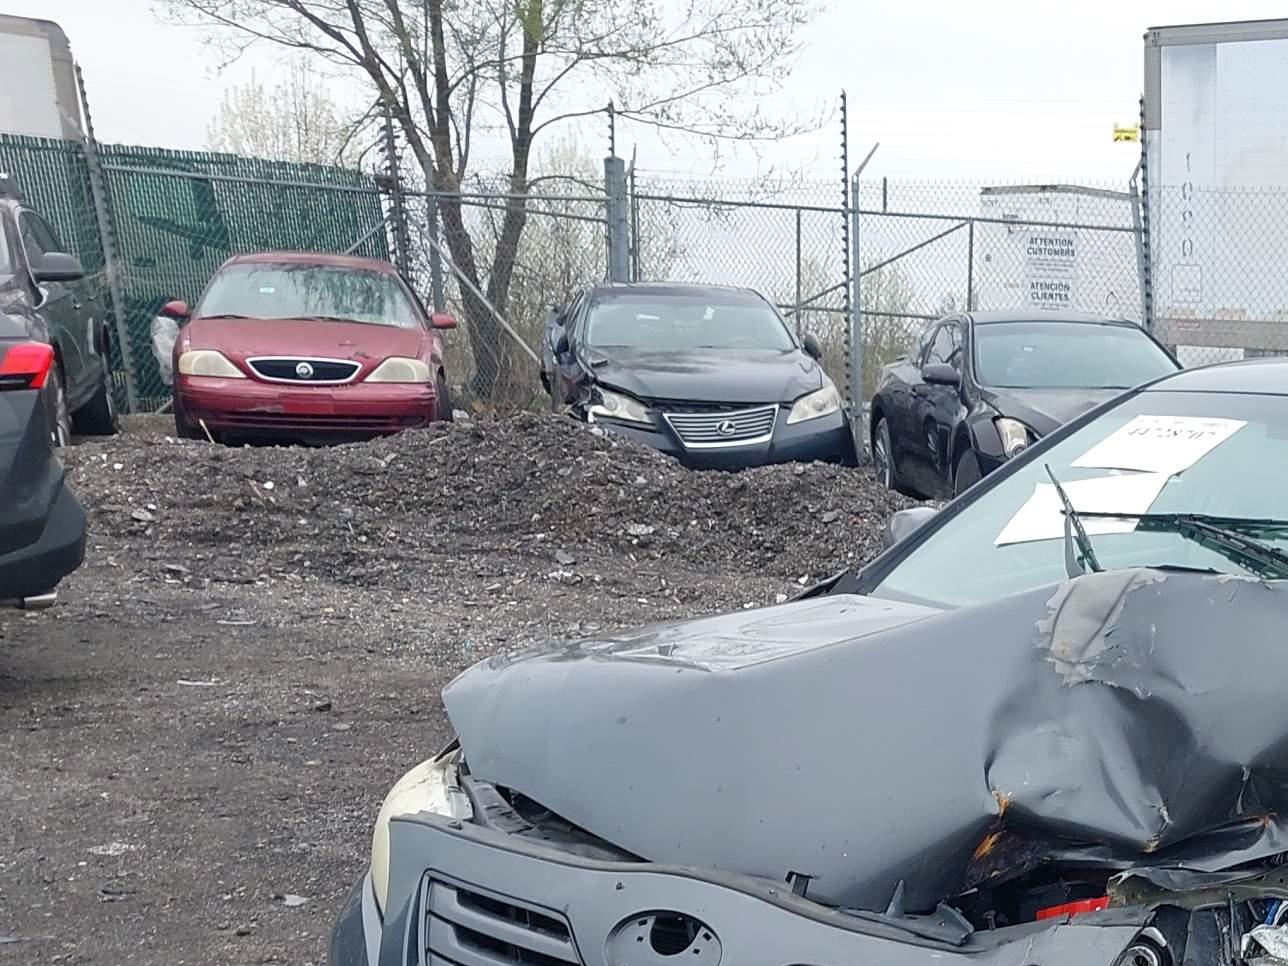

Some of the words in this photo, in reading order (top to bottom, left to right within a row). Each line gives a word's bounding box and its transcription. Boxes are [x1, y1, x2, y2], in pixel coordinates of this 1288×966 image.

[1029, 237, 1073, 247] ATTENTION
[1026, 247, 1075, 257] CUSTOMERS
[1030, 291, 1069, 301] CLIENTES
